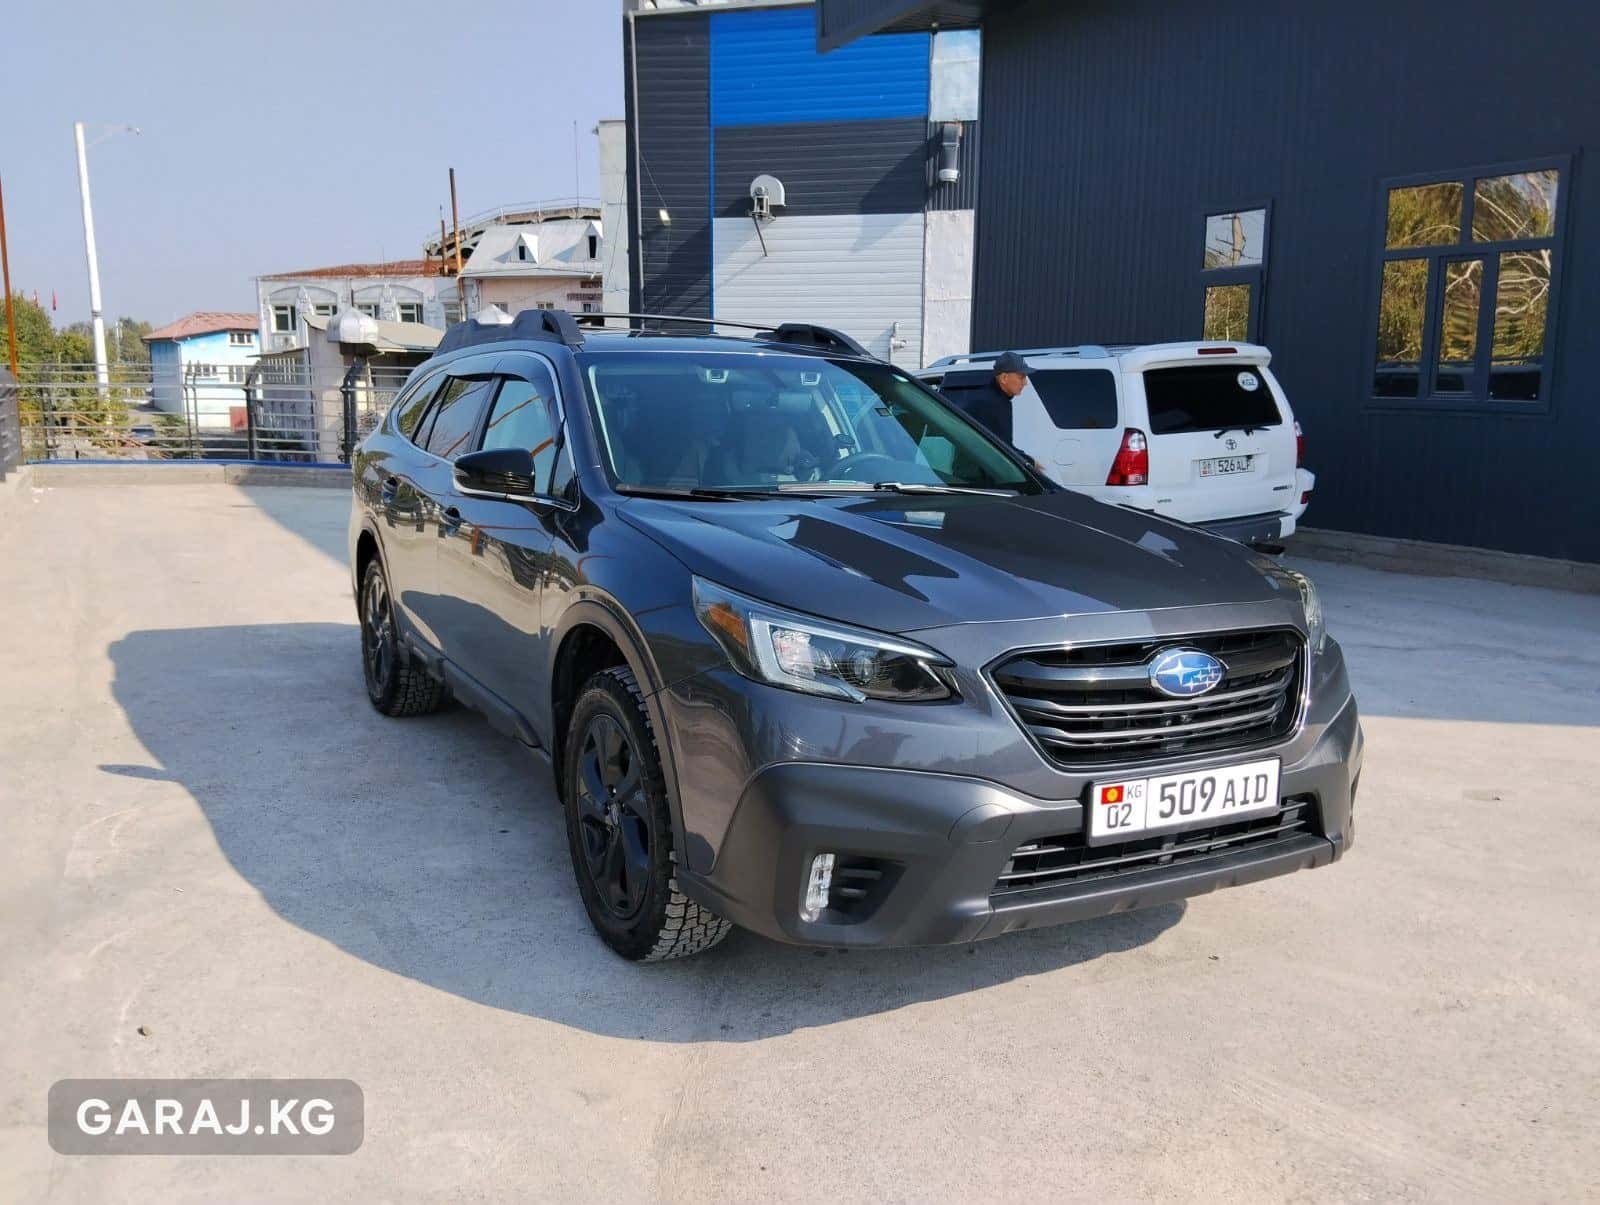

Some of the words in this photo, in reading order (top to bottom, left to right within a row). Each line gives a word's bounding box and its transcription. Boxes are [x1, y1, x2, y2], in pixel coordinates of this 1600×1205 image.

[1218, 459, 1235, 473] 526
[1126, 784, 1142, 800] KG
[1159, 776, 1217, 819] 509
[1222, 773, 1268, 809] AID
[1106, 803, 1133, 829] 02
